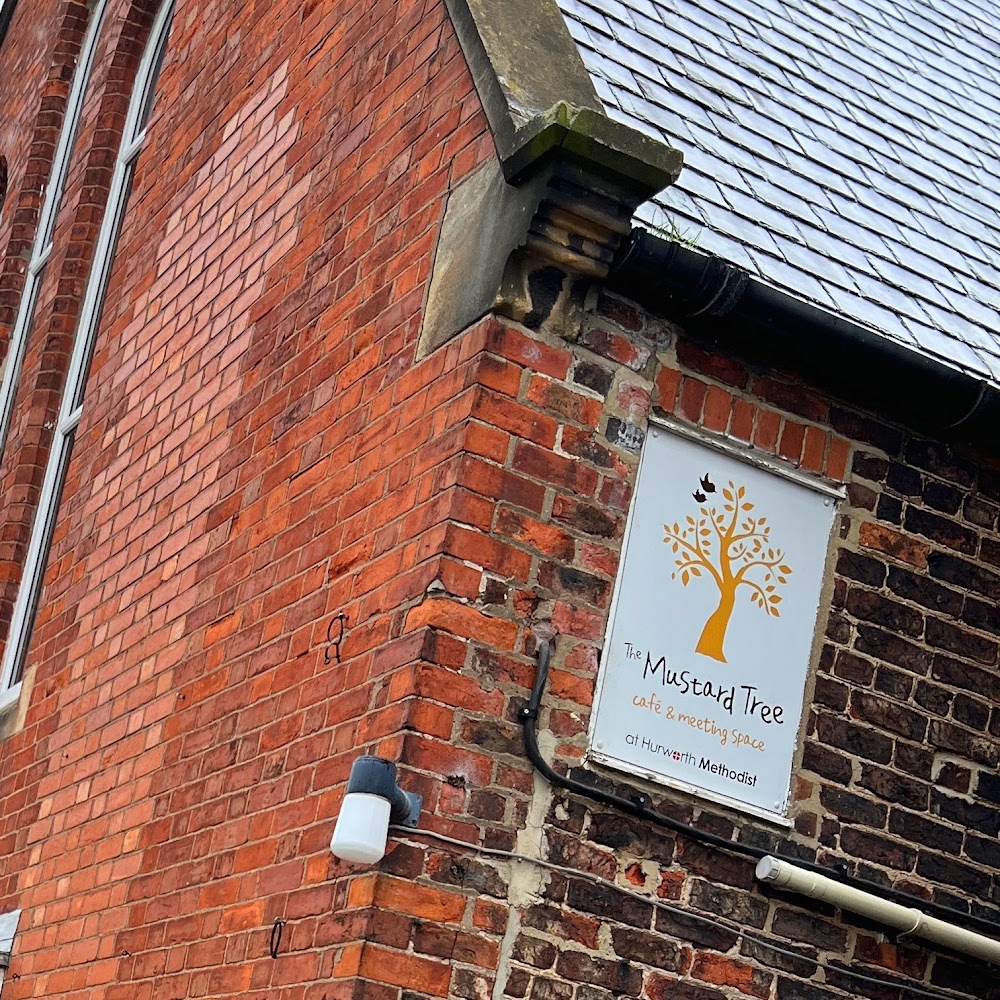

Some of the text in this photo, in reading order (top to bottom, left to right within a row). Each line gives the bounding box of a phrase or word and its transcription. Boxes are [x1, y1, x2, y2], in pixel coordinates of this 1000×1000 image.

[624, 642, 784, 724] The Mustard Tree
[632, 693, 662, 715] café
[666, 706, 675, 720] &
[678, 713, 728, 745] meeting
[625, 733, 639, 746] at
[699, 757, 758, 787] Methodist
